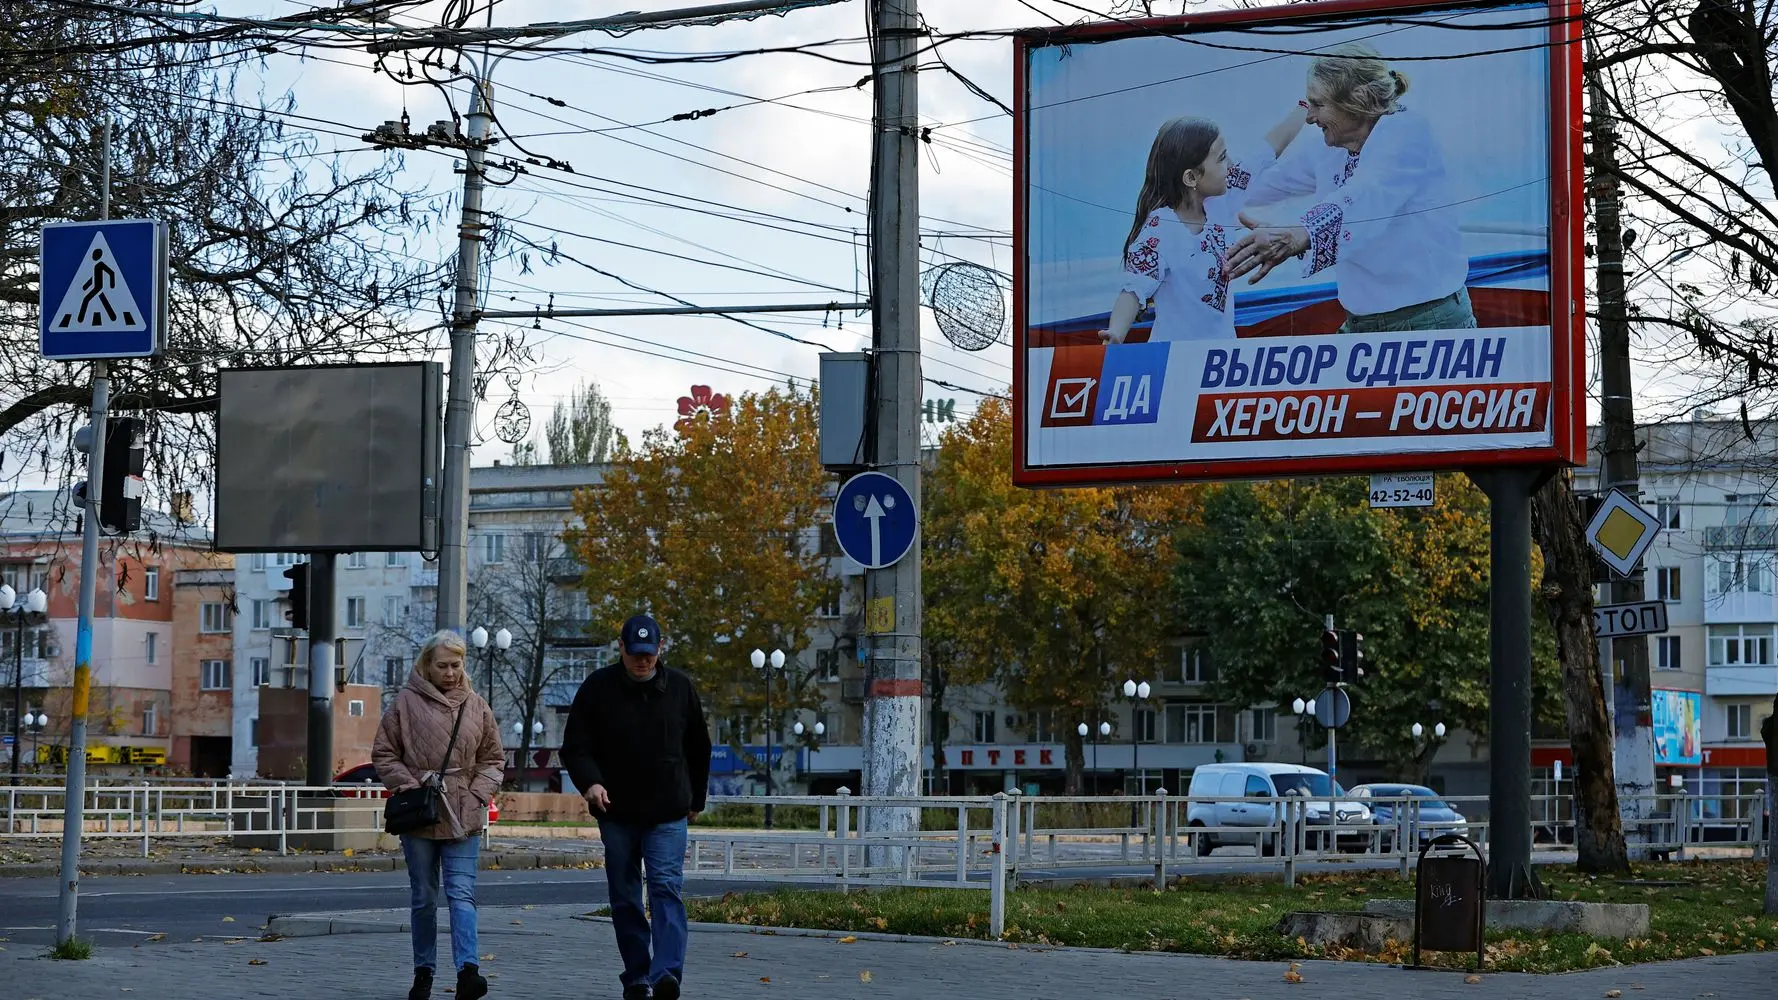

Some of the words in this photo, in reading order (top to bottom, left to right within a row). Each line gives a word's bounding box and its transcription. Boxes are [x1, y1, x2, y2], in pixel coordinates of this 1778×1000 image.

[1200, 344, 1338, 389] ВЫБОР
[1345, 337, 1507, 387] СДЕЛАН
[1103, 374, 1151, 421] ДА
[1205, 394, 1350, 437] ХЕРСОН
[1389, 388, 1538, 431] РОССИЯ
[1370, 488, 1433, 503] 42-52-40
